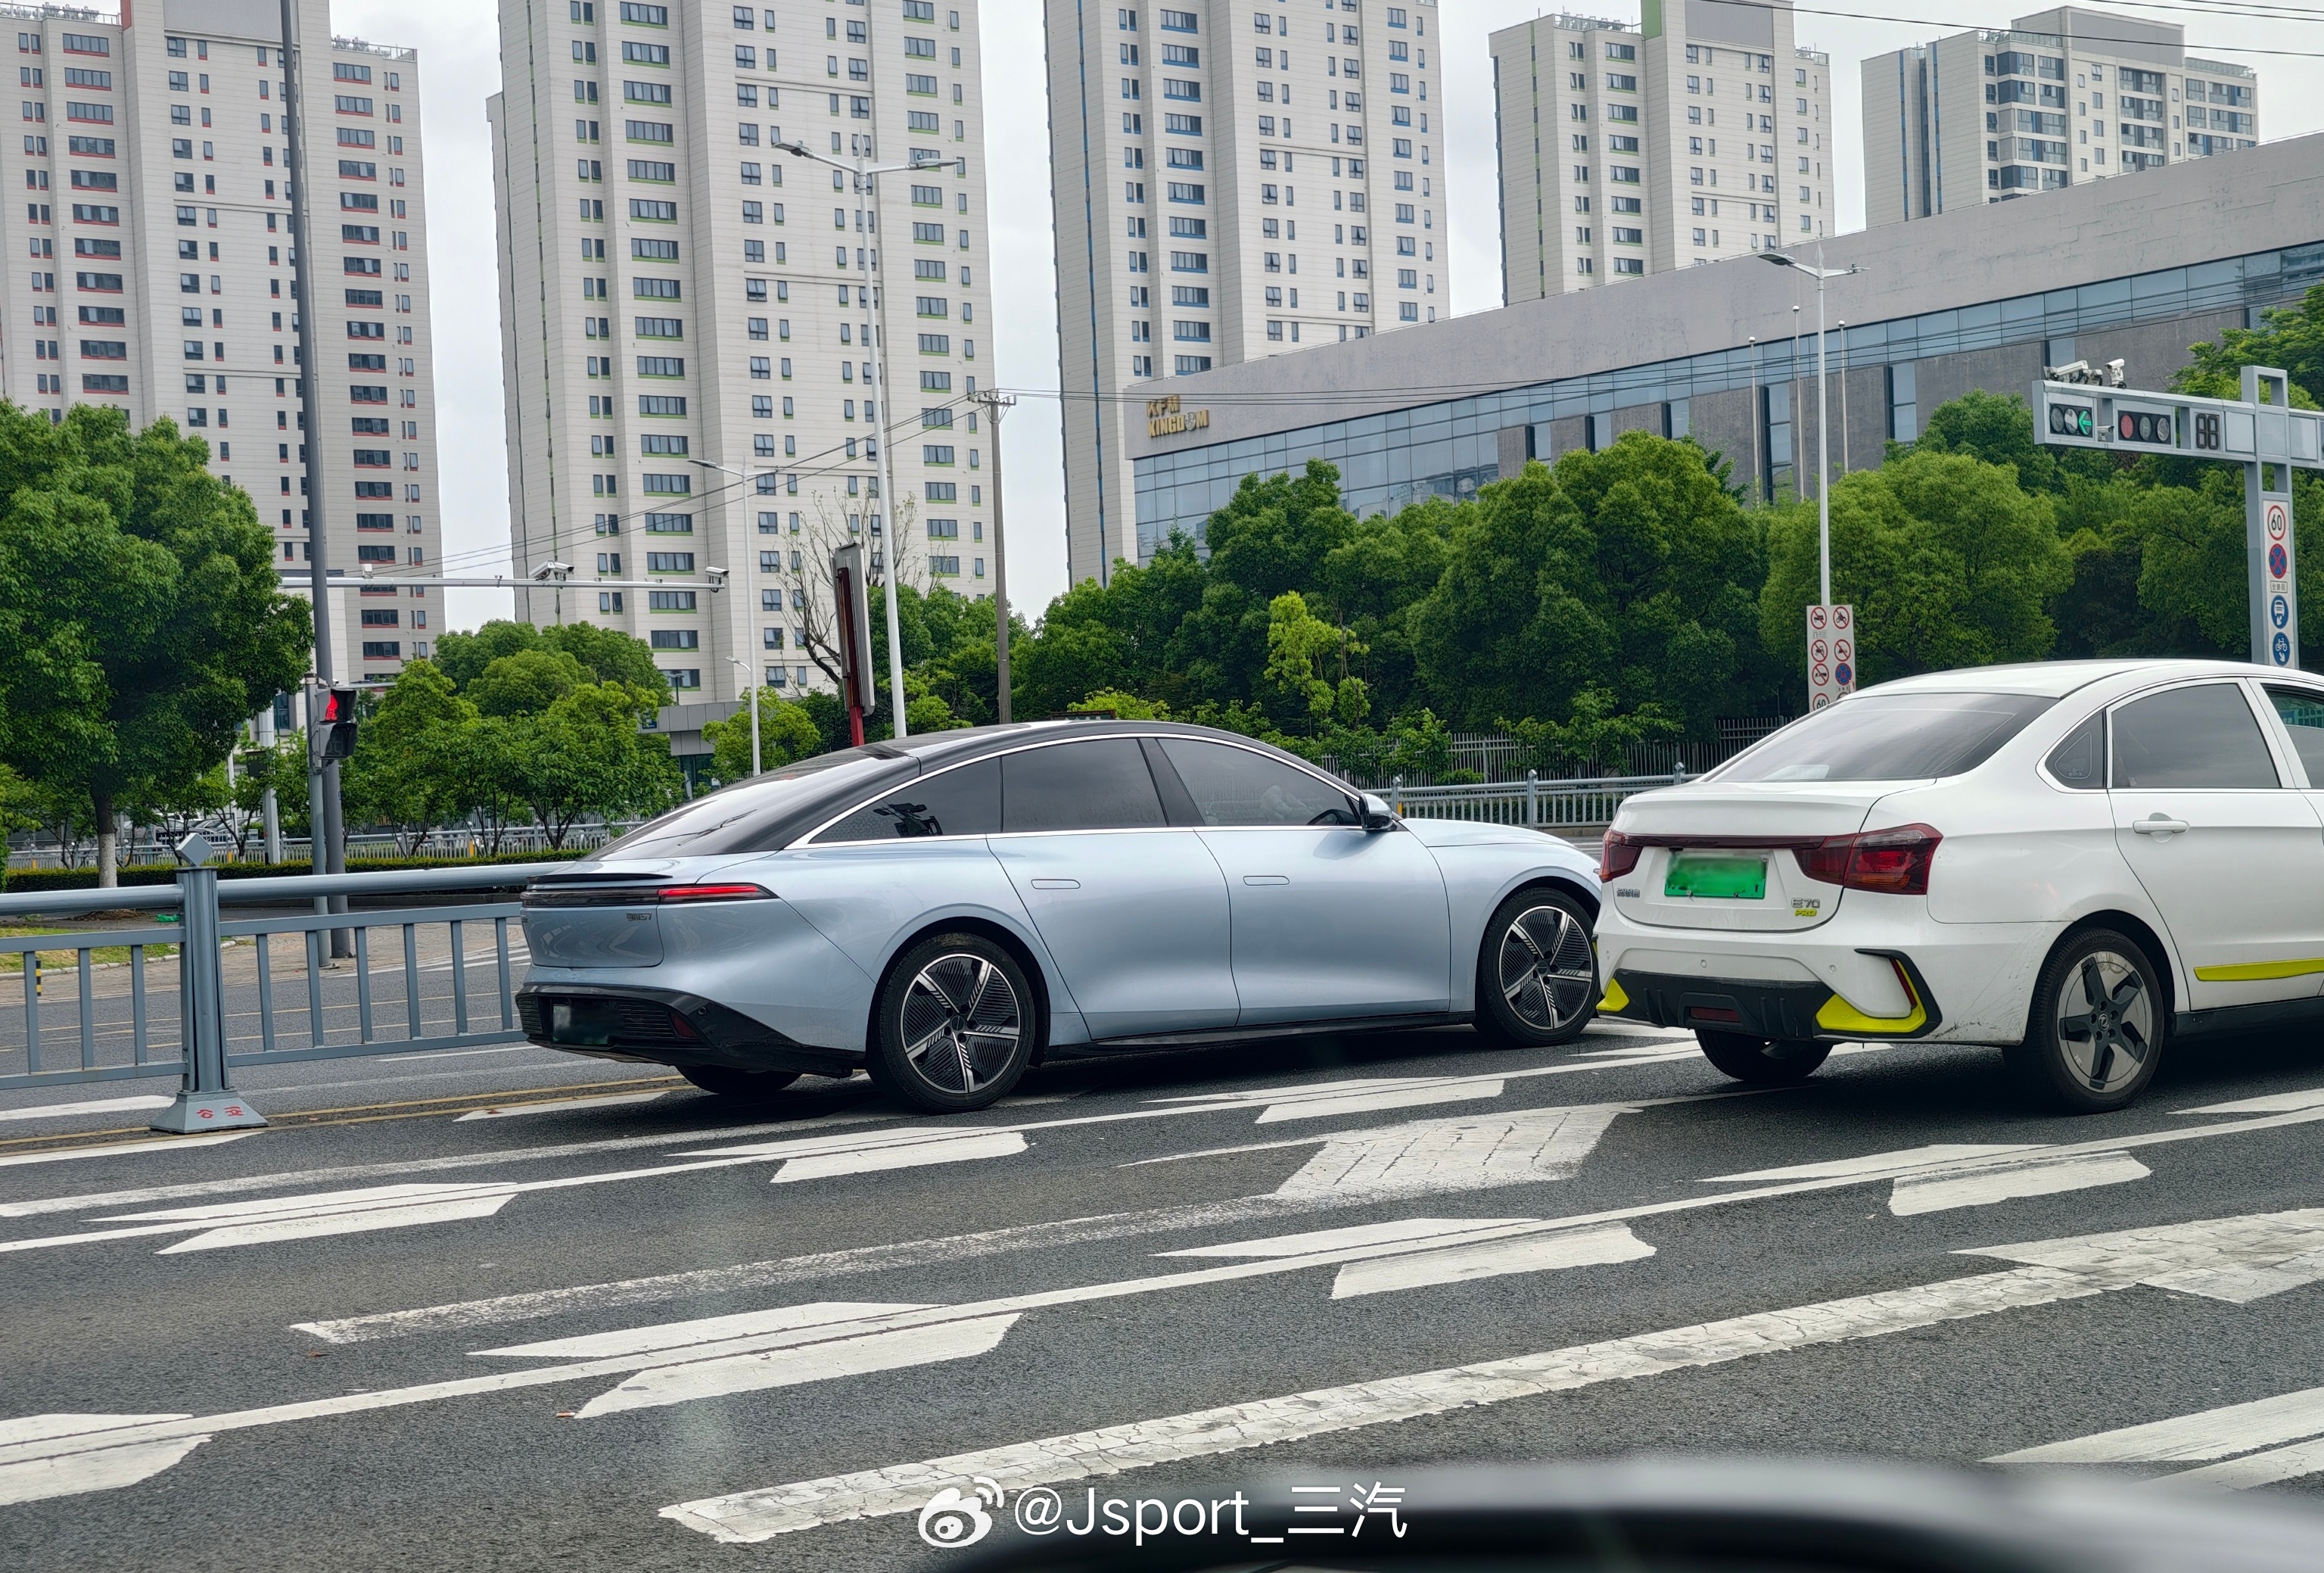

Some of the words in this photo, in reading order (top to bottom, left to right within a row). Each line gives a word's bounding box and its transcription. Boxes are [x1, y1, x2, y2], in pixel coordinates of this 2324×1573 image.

[1146, 394, 1181, 418] KFM
[2271, 514, 2282, 531] 60
[1791, 898, 1820, 908] E70
